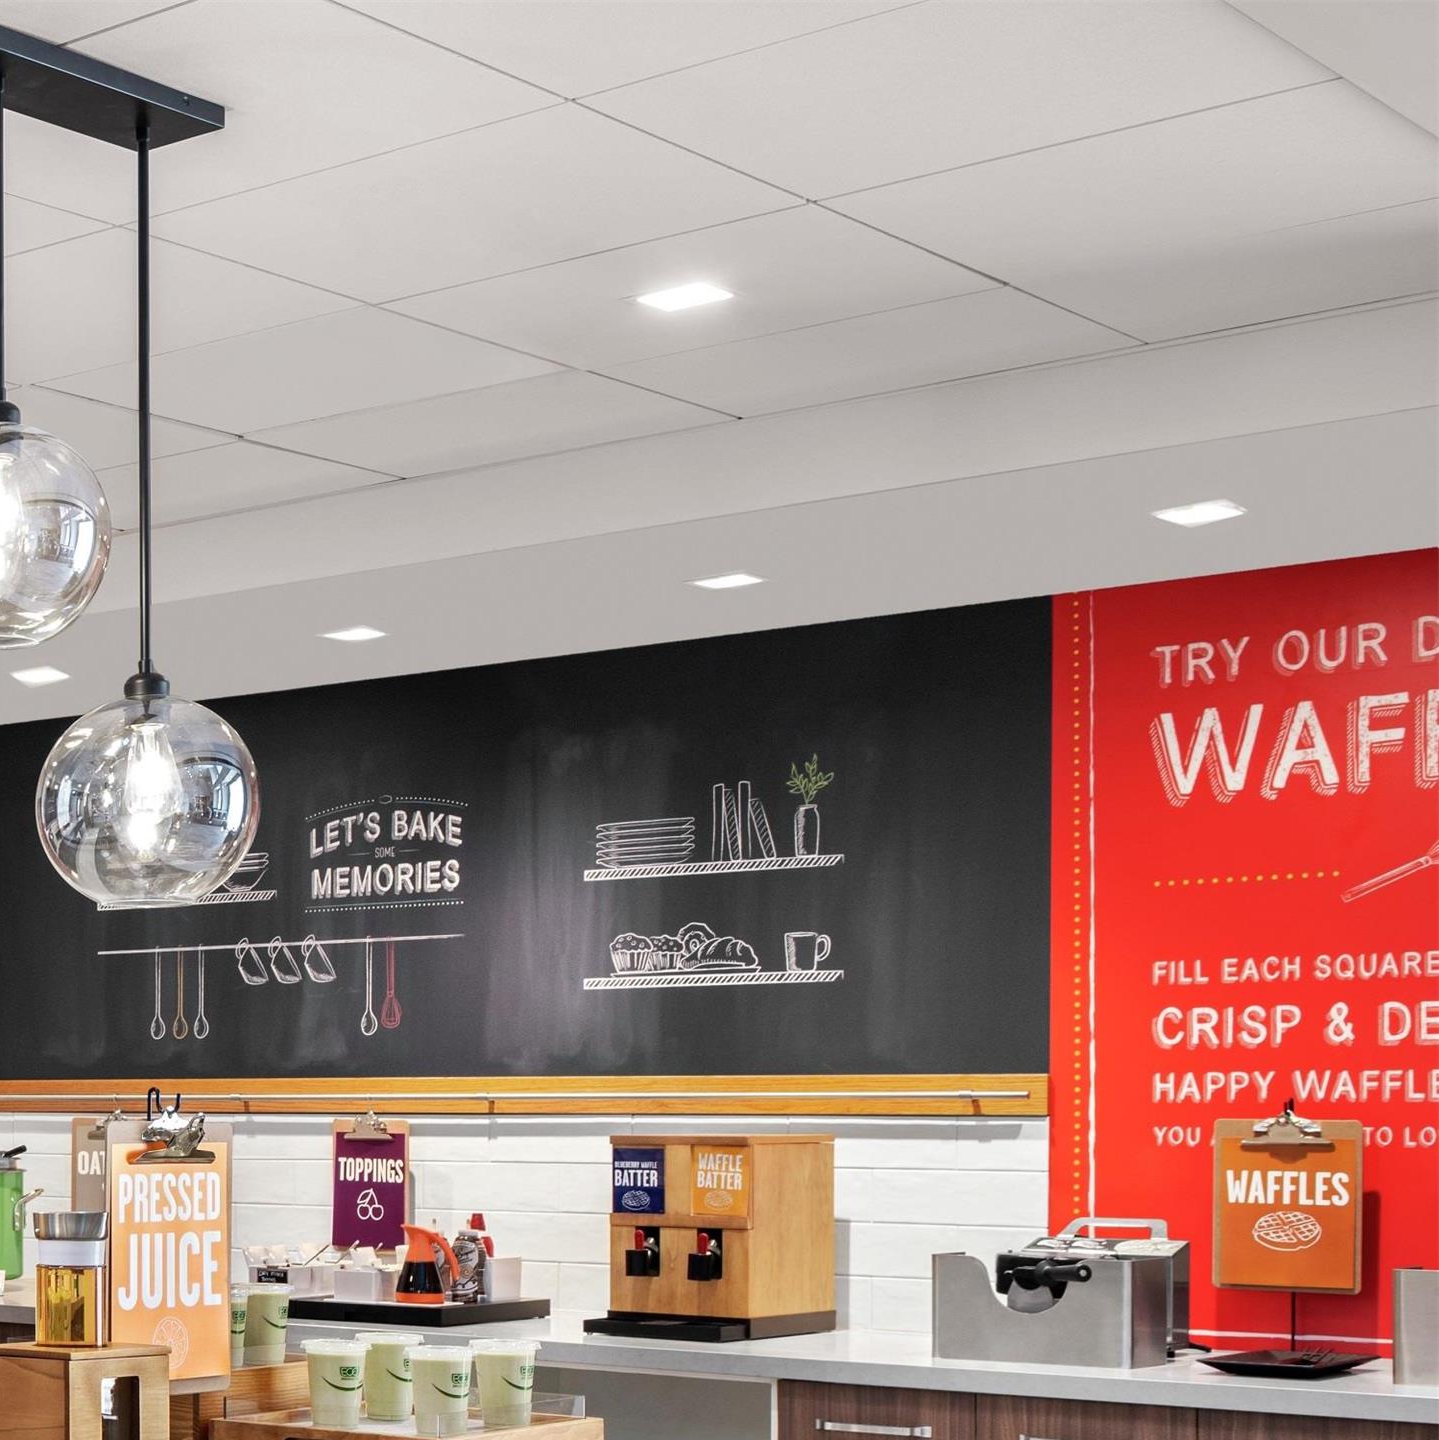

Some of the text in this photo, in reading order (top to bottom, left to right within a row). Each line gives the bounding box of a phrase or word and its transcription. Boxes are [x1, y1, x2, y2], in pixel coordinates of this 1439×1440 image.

[1150, 636, 1250, 688] TRY
[1273, 622, 1388, 677] OUR
[310, 810, 463, 859] LET'S BAKE
[374, 846, 396, 858] SOME
[311, 859, 460, 900] MEMORIES
[1151, 960, 1209, 986] FILL
[1221, 956, 1302, 984] EACH
[1152, 1004, 1302, 1050] CRISP
[1325, 1001, 1355, 1046] &
[1152, 1071, 1275, 1103] HAPPY
[1153, 1126, 1201, 1147] YOU
[338, 1157, 404, 1184] TOPPINGS
[640, 1161, 657, 1169] WAFFLE
[698, 1152, 743, 1172] WAFFLE
[614, 1169, 658, 1188] BATTER
[697, 1171, 743, 1190] BATTER
[1226, 1169, 1350, 1206] WAFFLES
[118, 1171, 221, 1224] PRESSED
[118, 1230, 222, 1311] JUICE
